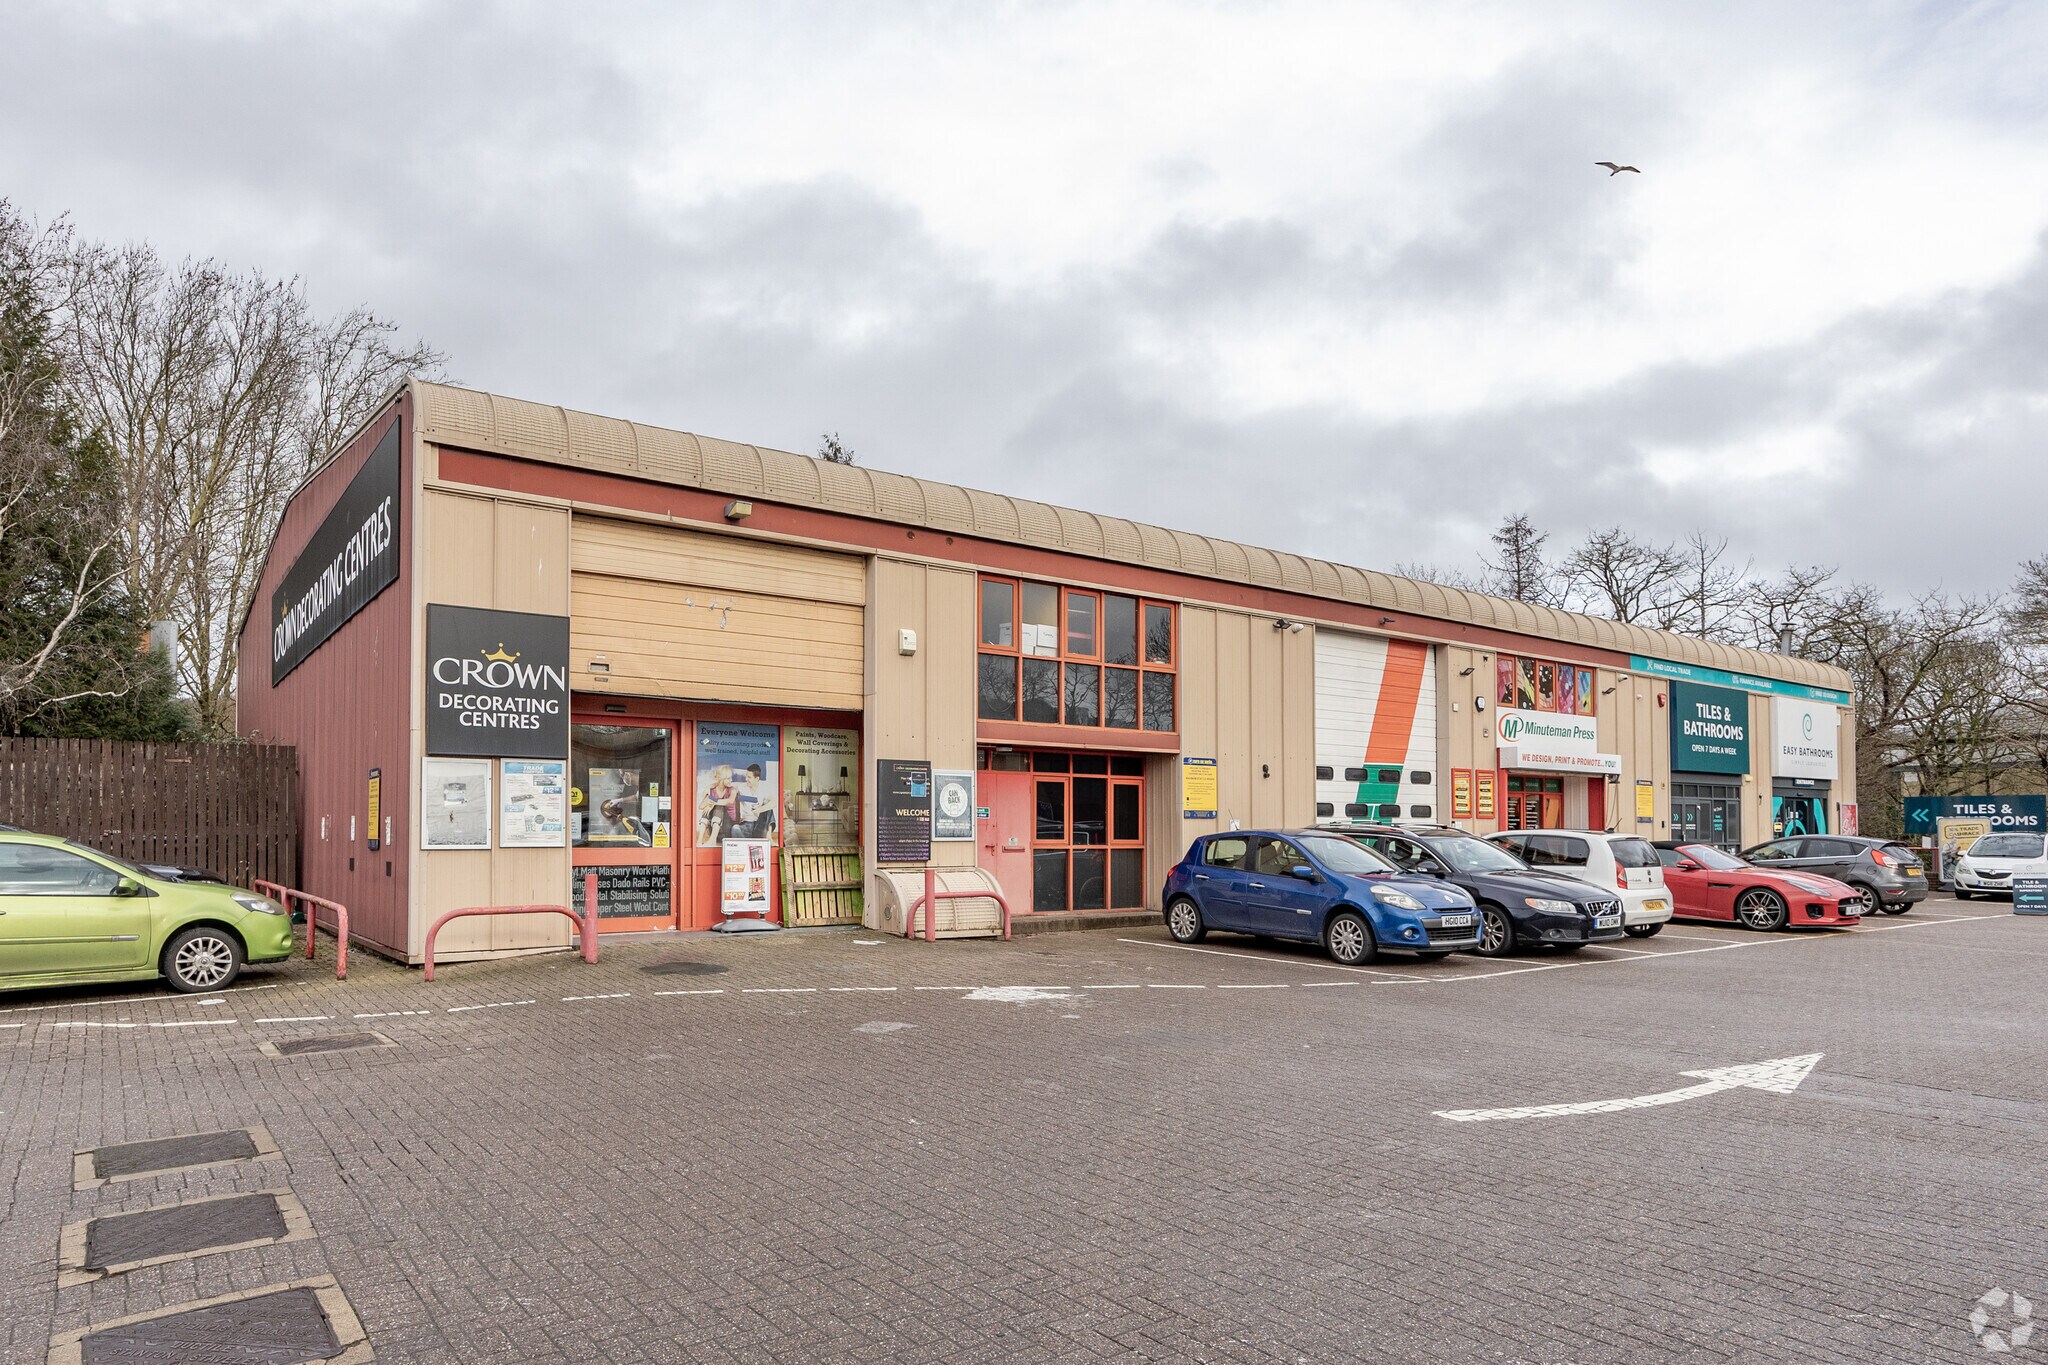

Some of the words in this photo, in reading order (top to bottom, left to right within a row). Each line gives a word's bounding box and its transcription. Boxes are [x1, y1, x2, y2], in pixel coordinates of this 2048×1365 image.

[274, 604, 298, 662] CROWN
[297, 552, 343, 639] DECORATING
[345, 495, 391, 586] CENTRES
[433, 657, 565, 692] CROWN
[439, 693, 559, 714] DECORATING
[1696, 702, 1722, 720] TILES
[1724, 706, 1731, 721] &
[460, 711, 540, 730] CENTRES
[701, 726, 738, 737] Everyone
[740, 729, 776, 738] Welcome
[796, 731, 816, 739] Paints,
[1525, 721, 1572, 738] Minuteman
[1573, 726, 1595, 740] Press
[1684, 720, 1744, 740] BATHROOMS
[812, 740, 843, 748] Coverings
[1692, 744, 1704, 752] OPEN
[786, 747, 820, 755] Decorating
[1783, 746, 1797, 755] EASY
[1799, 747, 1833, 758] BATHROOMS
[1522, 754, 1531, 762] WE
[1532, 754, 1554, 763] DESIGN,
[1555, 756, 1571, 764] PRINT
[1953, 804, 1996, 814] TILES
[2001, 804, 2012, 814] &
[599, 866, 631, 878] Masonry
[632, 866, 651, 875] Work
[612, 878, 630, 888] Dado
[633, 878, 650, 888] Rails
[610, 890, 648, 901] Stabilising
[614, 903, 632, 913] Steel
[633, 902, 652, 912] Wool
[170, 1340, 234, 1352] DUCTILE
[108, 1349, 176, 1361] STANTON
[188, 1354, 265, 1365] STAVELEY
